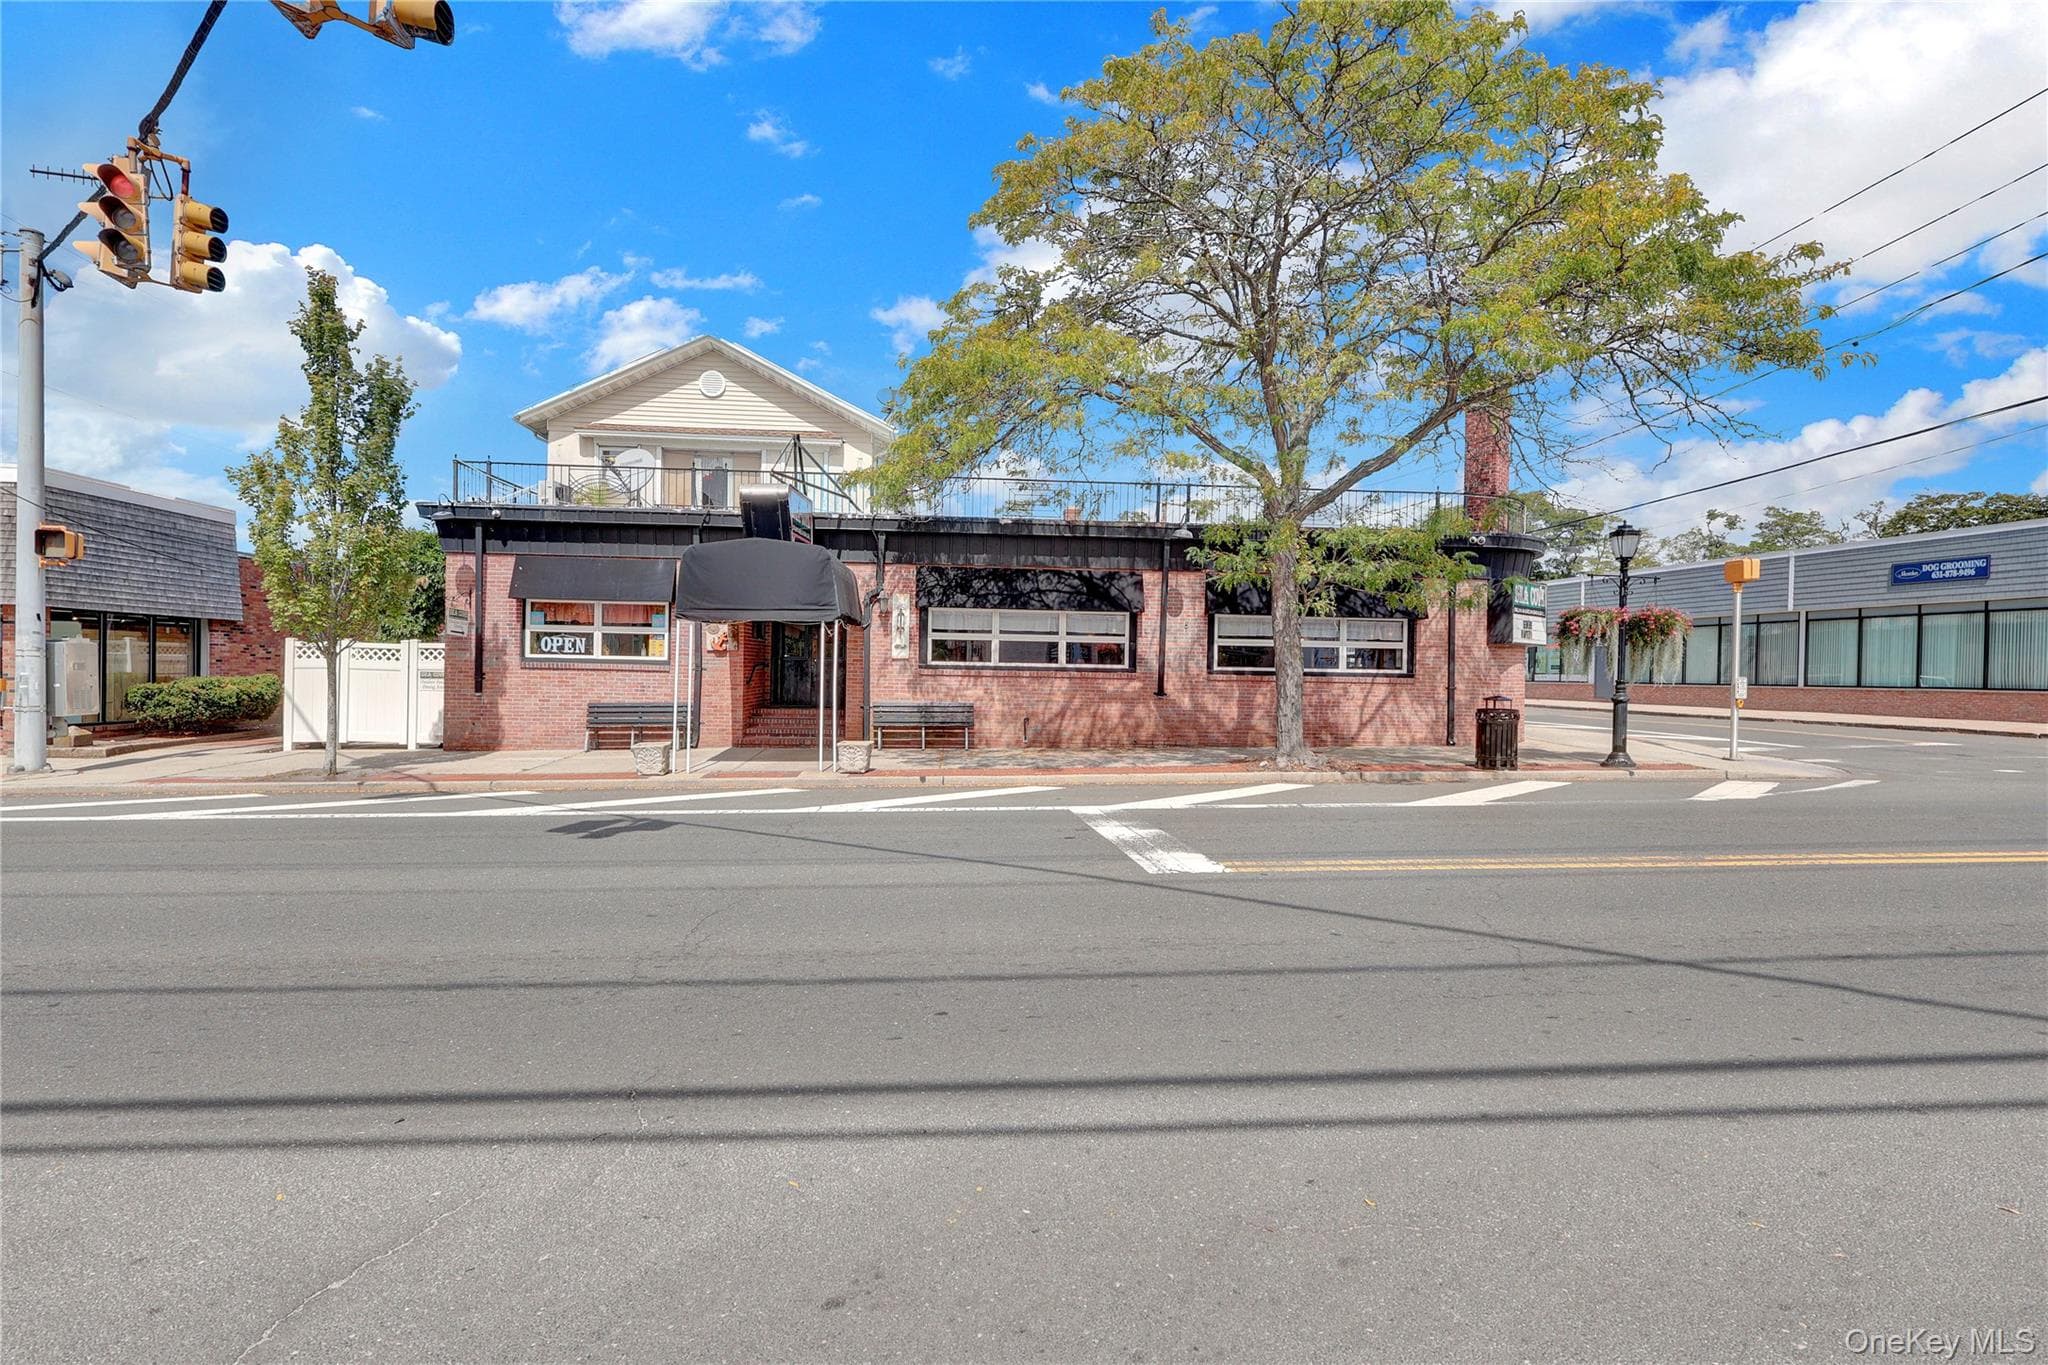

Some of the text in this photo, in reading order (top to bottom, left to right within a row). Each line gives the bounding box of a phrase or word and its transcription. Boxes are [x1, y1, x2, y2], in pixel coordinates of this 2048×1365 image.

[1922, 559, 1987, 572] DOG GROOMING
[540, 636, 587, 654] OPEN
